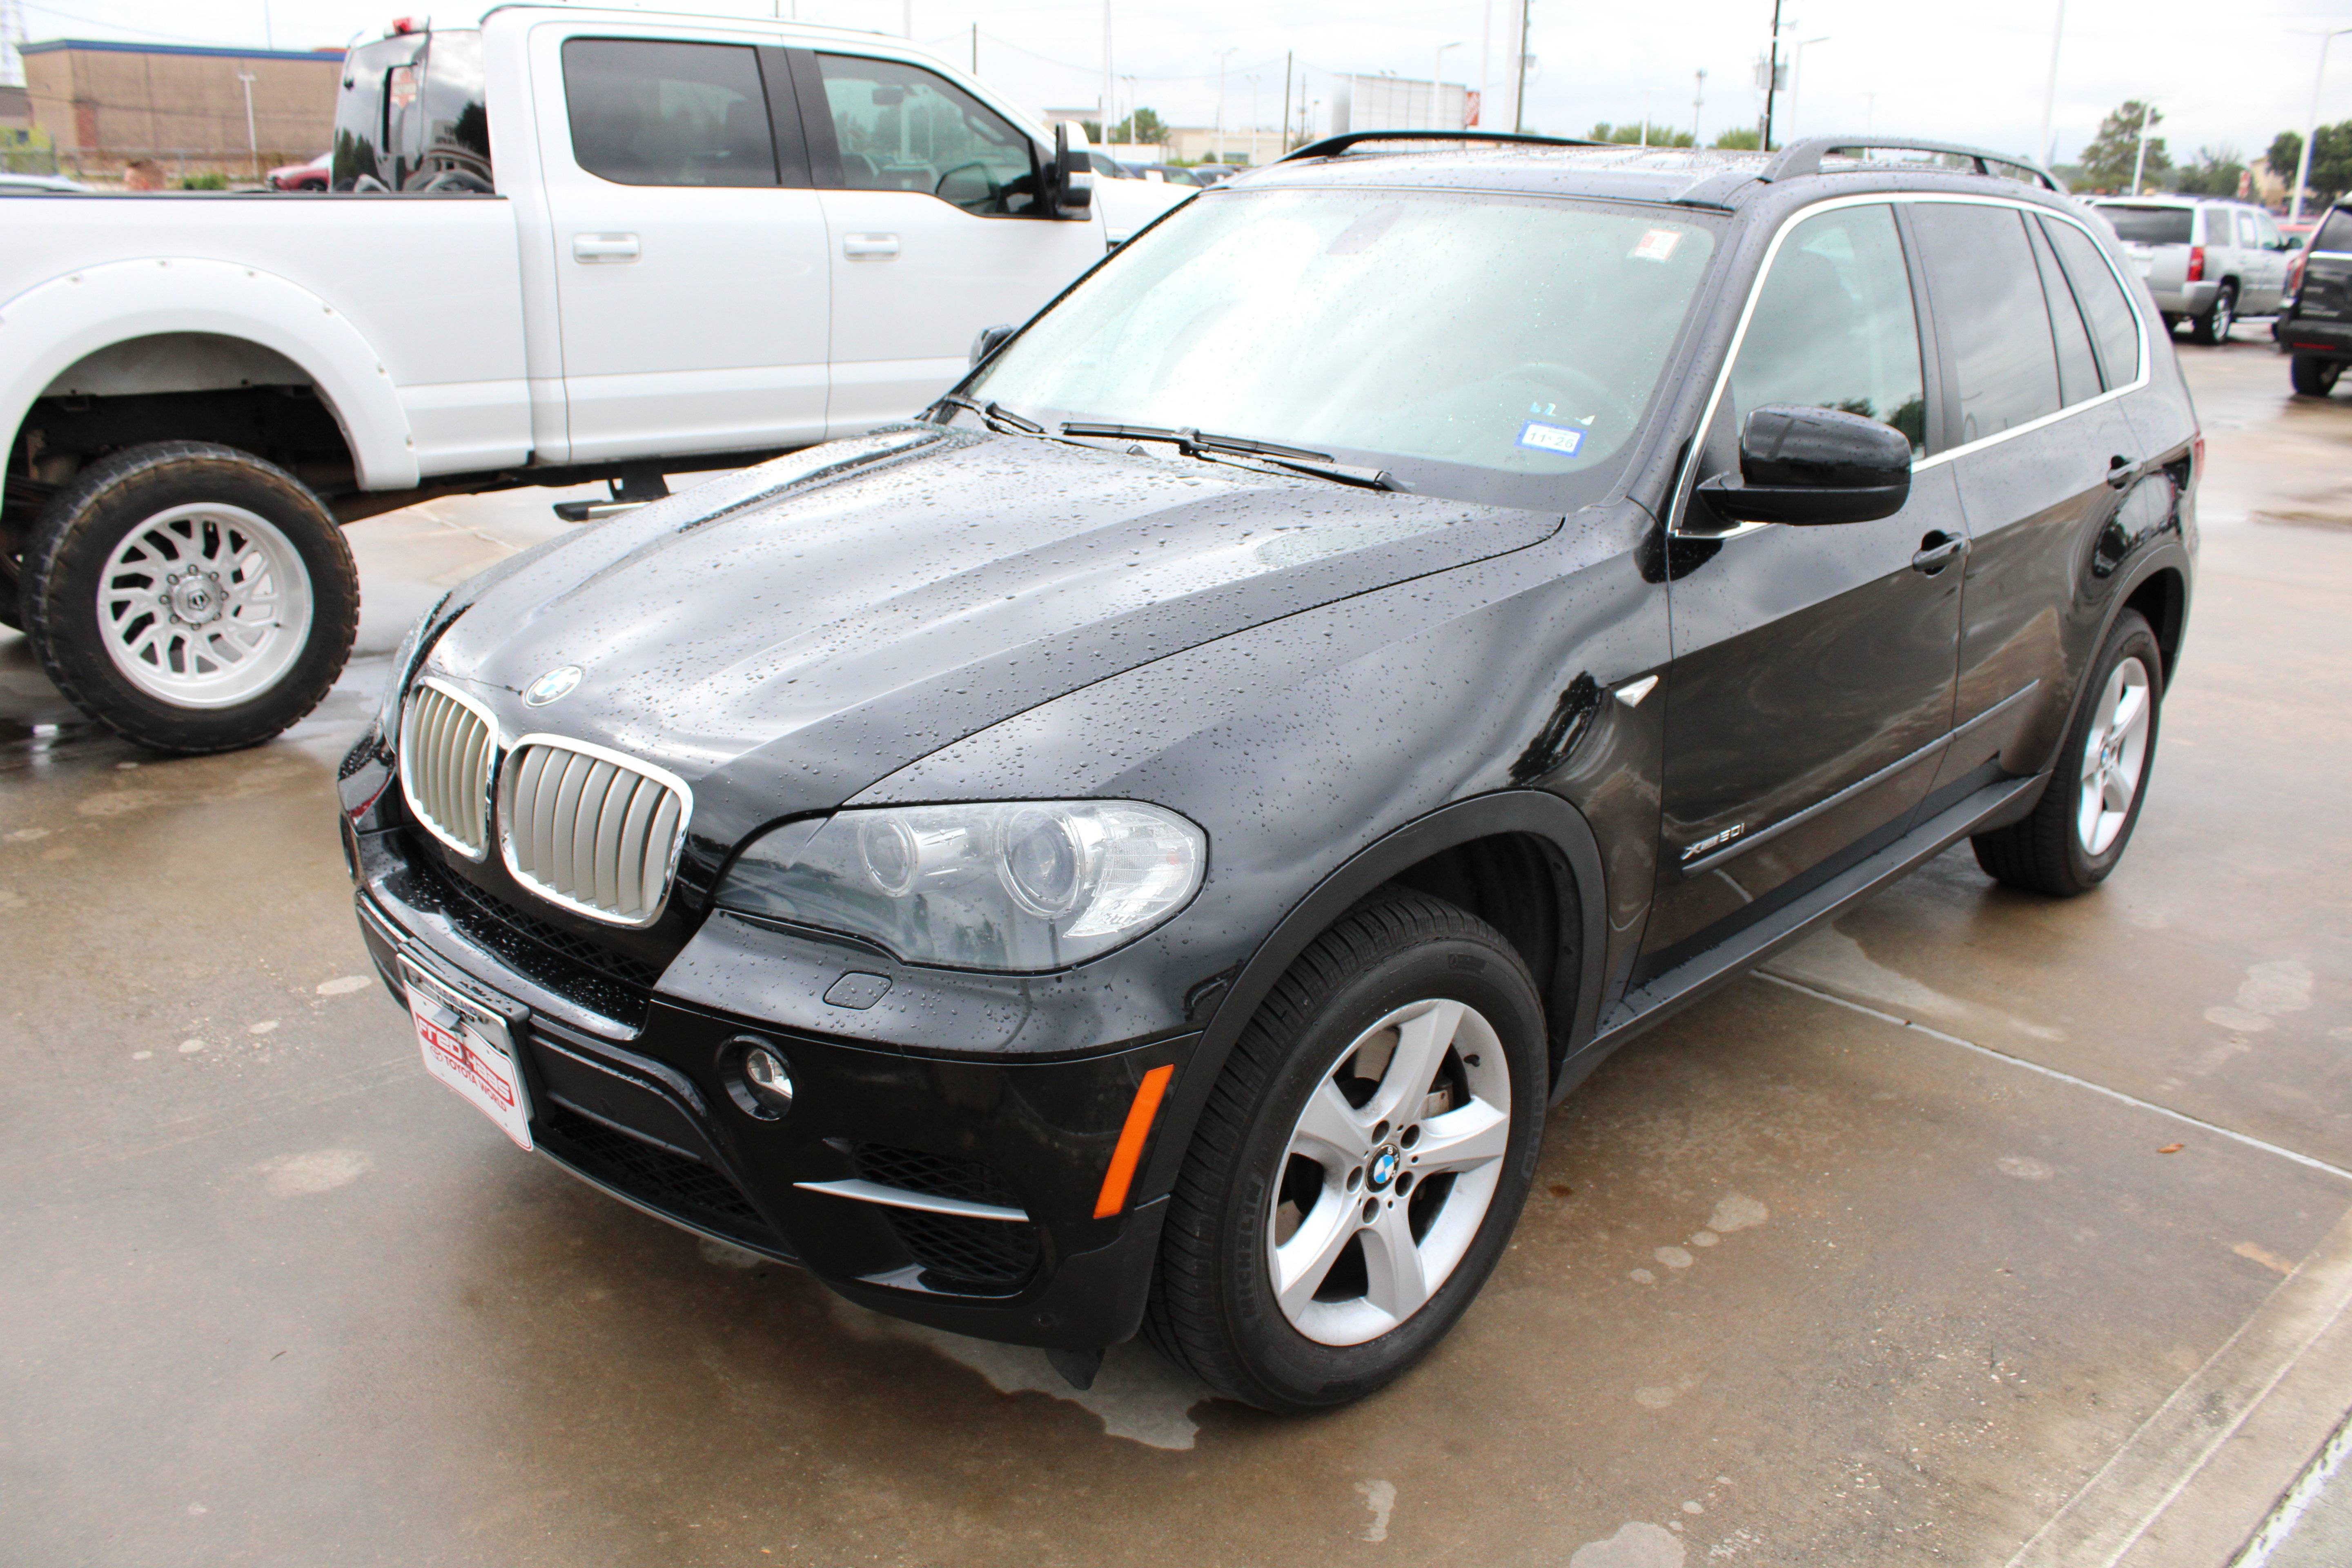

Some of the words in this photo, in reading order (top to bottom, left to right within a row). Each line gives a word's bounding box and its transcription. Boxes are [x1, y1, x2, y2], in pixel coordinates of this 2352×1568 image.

[1553, 436, 1575, 449] 26
[444, 1055, 478, 1087] TOYOTA
[478, 1079, 507, 1112] WORLD
[1237, 1181, 1262, 1318] MICHELIN
